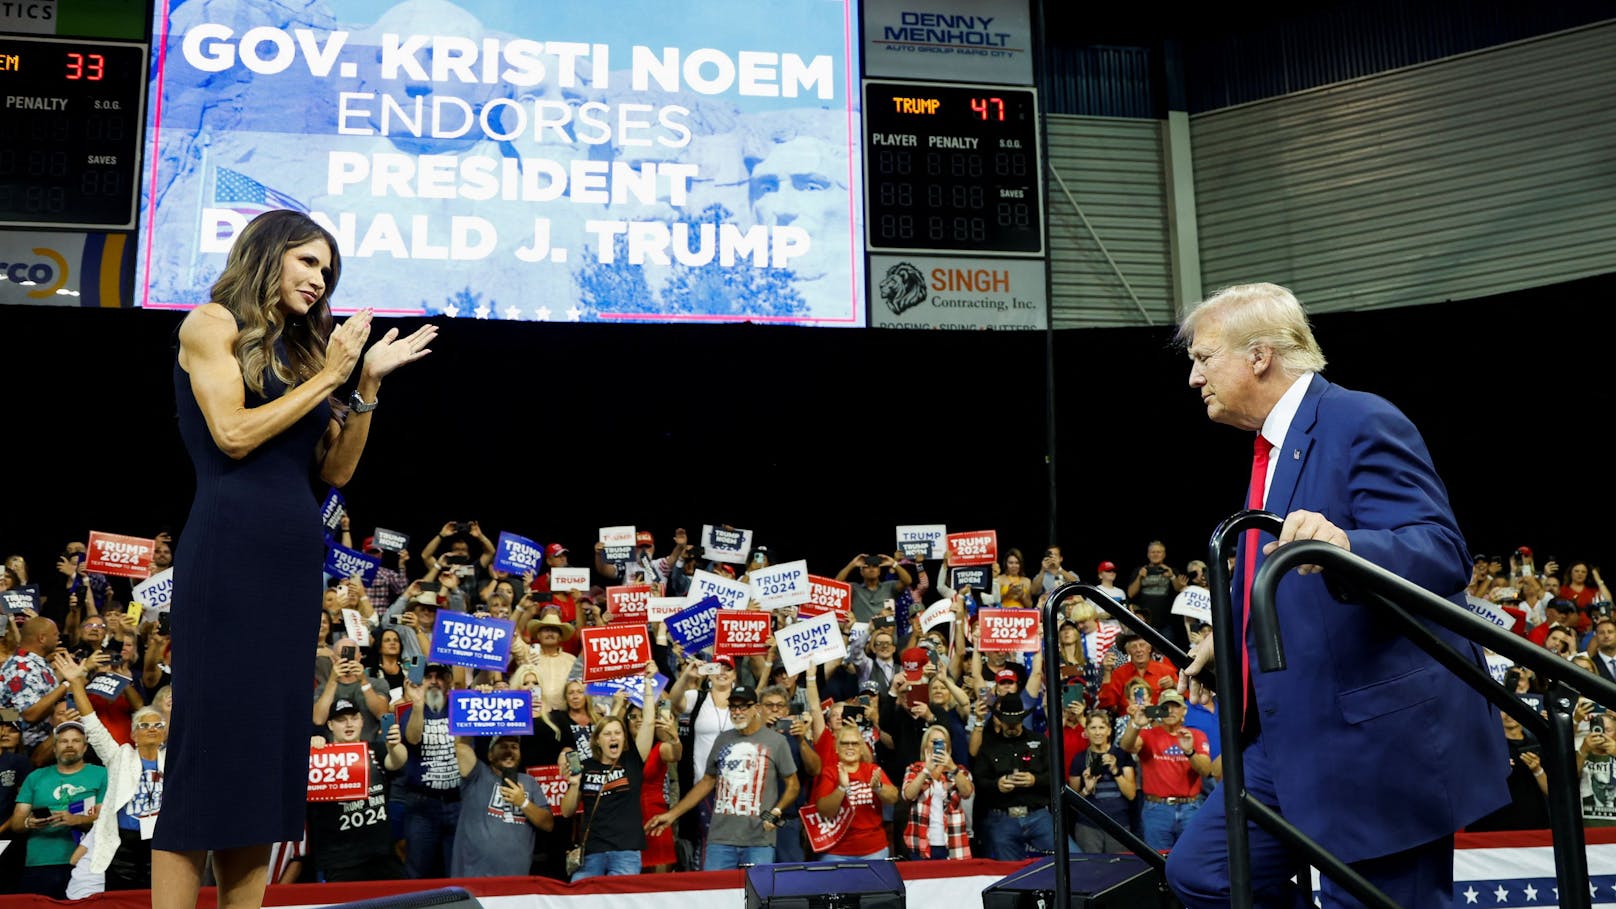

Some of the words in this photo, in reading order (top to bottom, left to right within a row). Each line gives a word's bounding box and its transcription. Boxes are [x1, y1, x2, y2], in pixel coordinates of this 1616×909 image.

[2, 2, 52, 20] TICS
[901, 12, 995, 30] DENNY
[884, 26, 1011, 47] MENHOLT
[885, 44, 916, 52] AUTO
[917, 46, 954, 54] GROUP
[65, 53, 104, 80] 33
[182, 23, 358, 78] GOV.
[381, 33, 609, 89] KRISTI
[632, 45, 834, 100] NOEM
[6, 95, 68, 111] PENALTY
[94, 100, 122, 110] S.O.G.
[892, 96, 941, 115] TRUMP
[971, 98, 1005, 121] 47
[337, 91, 692, 148] ENDORSES
[872, 133, 917, 147] PLAYER
[928, 136, 979, 149] PENALTY
[999, 139, 1022, 148] S.O.G.
[87, 155, 117, 165] SAVES
[327, 151, 699, 207] PRESIDENT
[1000, 189, 1024, 198] SAVES
[201, 207, 498, 261] DNALD
[514, 218, 567, 263] J.
[585, 220, 811, 268] TRUMP
[931, 268, 1010, 293] SINGH
[931, 295, 1008, 311] Contracting,
[1012, 297, 1036, 309] Inc.
[323, 494, 338, 526] UMP
[903, 532, 941, 540] TRUMP
[950, 536, 991, 548] TRUMP
[95, 539, 149, 555] TRUMP
[505, 540, 541, 560] TRUMP
[604, 546, 632, 554] TRUMP
[957, 546, 987, 555] 2024
[100, 550, 140, 565] 2024
[333, 548, 374, 570] TRUMP
[508, 551, 537, 568] 2024
[606, 552, 630, 560] NOEM
[334, 560, 365, 577] 2024
[957, 571, 983, 580] TRUMP
[756, 570, 801, 587] TRUMP
[140, 579, 174, 599] TRUM
[700, 580, 745, 600] TRUMP
[763, 582, 796, 596] 2024
[809, 583, 848, 599] TRUMP
[1184, 591, 1210, 602] TRU
[612, 592, 650, 604] TRUM
[811, 593, 842, 608] 2024
[1186, 598, 1209, 609] 202
[673, 607, 717, 633] TRUMP
[985, 616, 1034, 628] TRUMP
[1467, 604, 1505, 626] RUMP
[442, 620, 506, 641] TRUMP
[683, 619, 716, 641] 2024
[721, 620, 767, 632] TRUMP
[991, 627, 1028, 639] 2024
[447, 634, 494, 653] 2024
[588, 634, 644, 652] TRUMP
[727, 631, 761, 643] 2024
[784, 623, 831, 648] TRUMP
[452, 649, 474, 657] TRUMP
[793, 636, 828, 656] 2024
[598, 648, 639, 665] 2024
[457, 697, 525, 710] TRUMP
[466, 709, 516, 722] 2024
[309, 752, 359, 769] UMP
[308, 766, 350, 783] 024
[585, 768, 625, 784] TRUMP
[540, 780, 569, 794] 024
[340, 806, 387, 831] 2024
